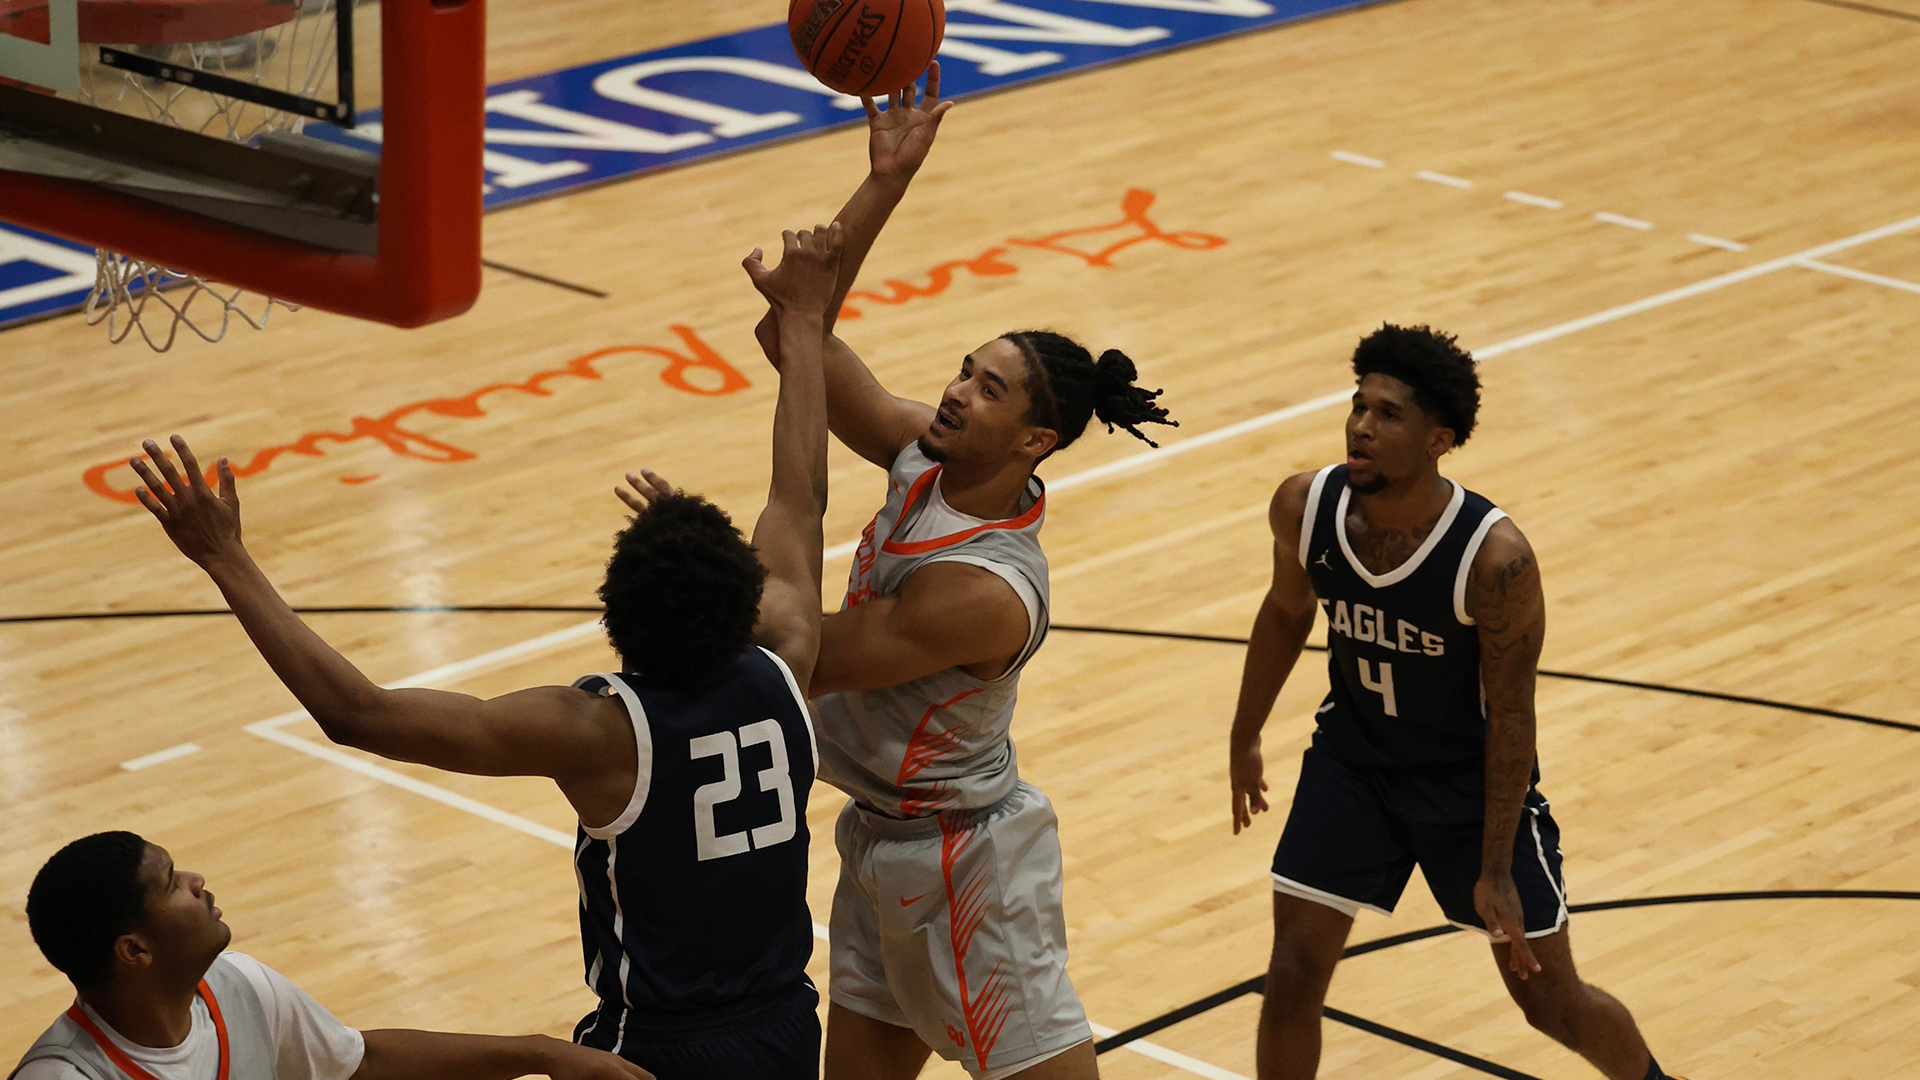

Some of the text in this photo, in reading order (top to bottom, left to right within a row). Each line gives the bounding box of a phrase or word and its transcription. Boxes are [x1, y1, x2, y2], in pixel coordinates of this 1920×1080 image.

[825, 4, 885, 89] SPALDIN
[1357, 656, 1398, 718] 4
[689, 718, 797, 862] 23
